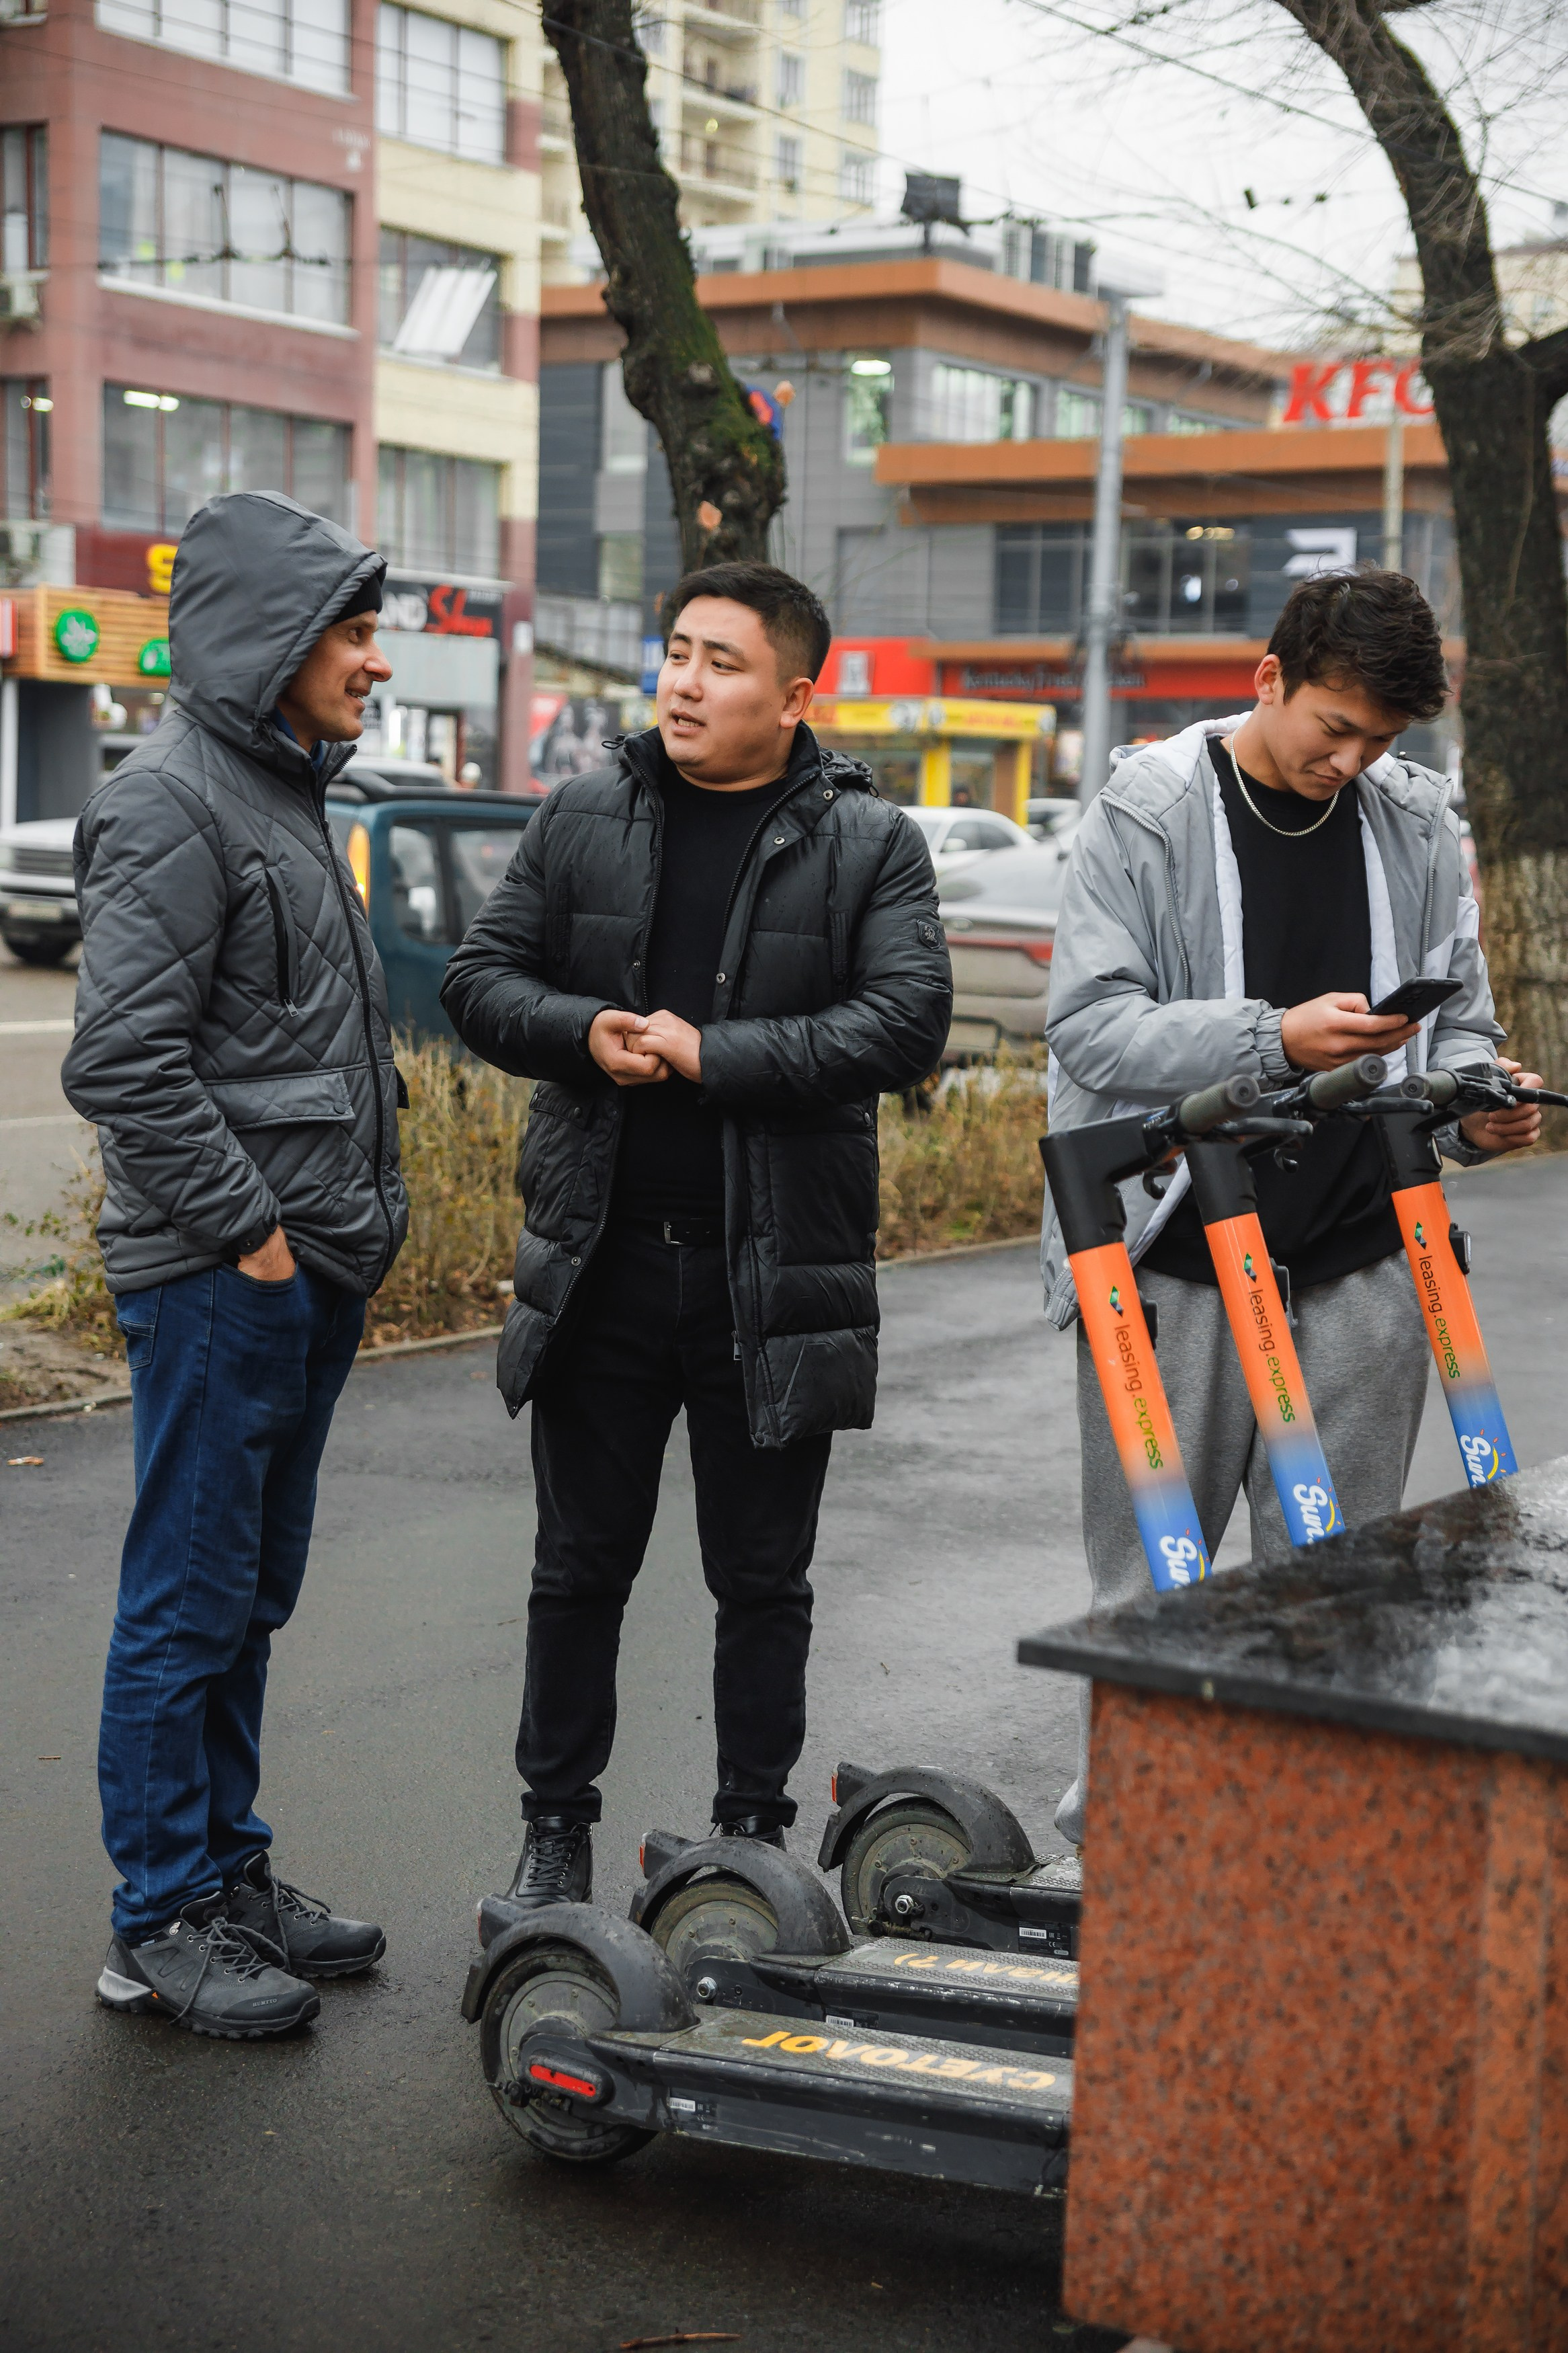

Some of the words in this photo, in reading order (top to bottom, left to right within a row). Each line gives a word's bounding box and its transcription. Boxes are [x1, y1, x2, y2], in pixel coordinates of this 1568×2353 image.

[1283, 358, 1435, 422] KFC
[1249, 1289, 1296, 1423] leasing.express
[1419, 1255, 1460, 1379] leasing.express
[1114, 1324, 1164, 1470] leasing.express
[742, 2030, 1056, 2090] СУЕТОЛОГ
